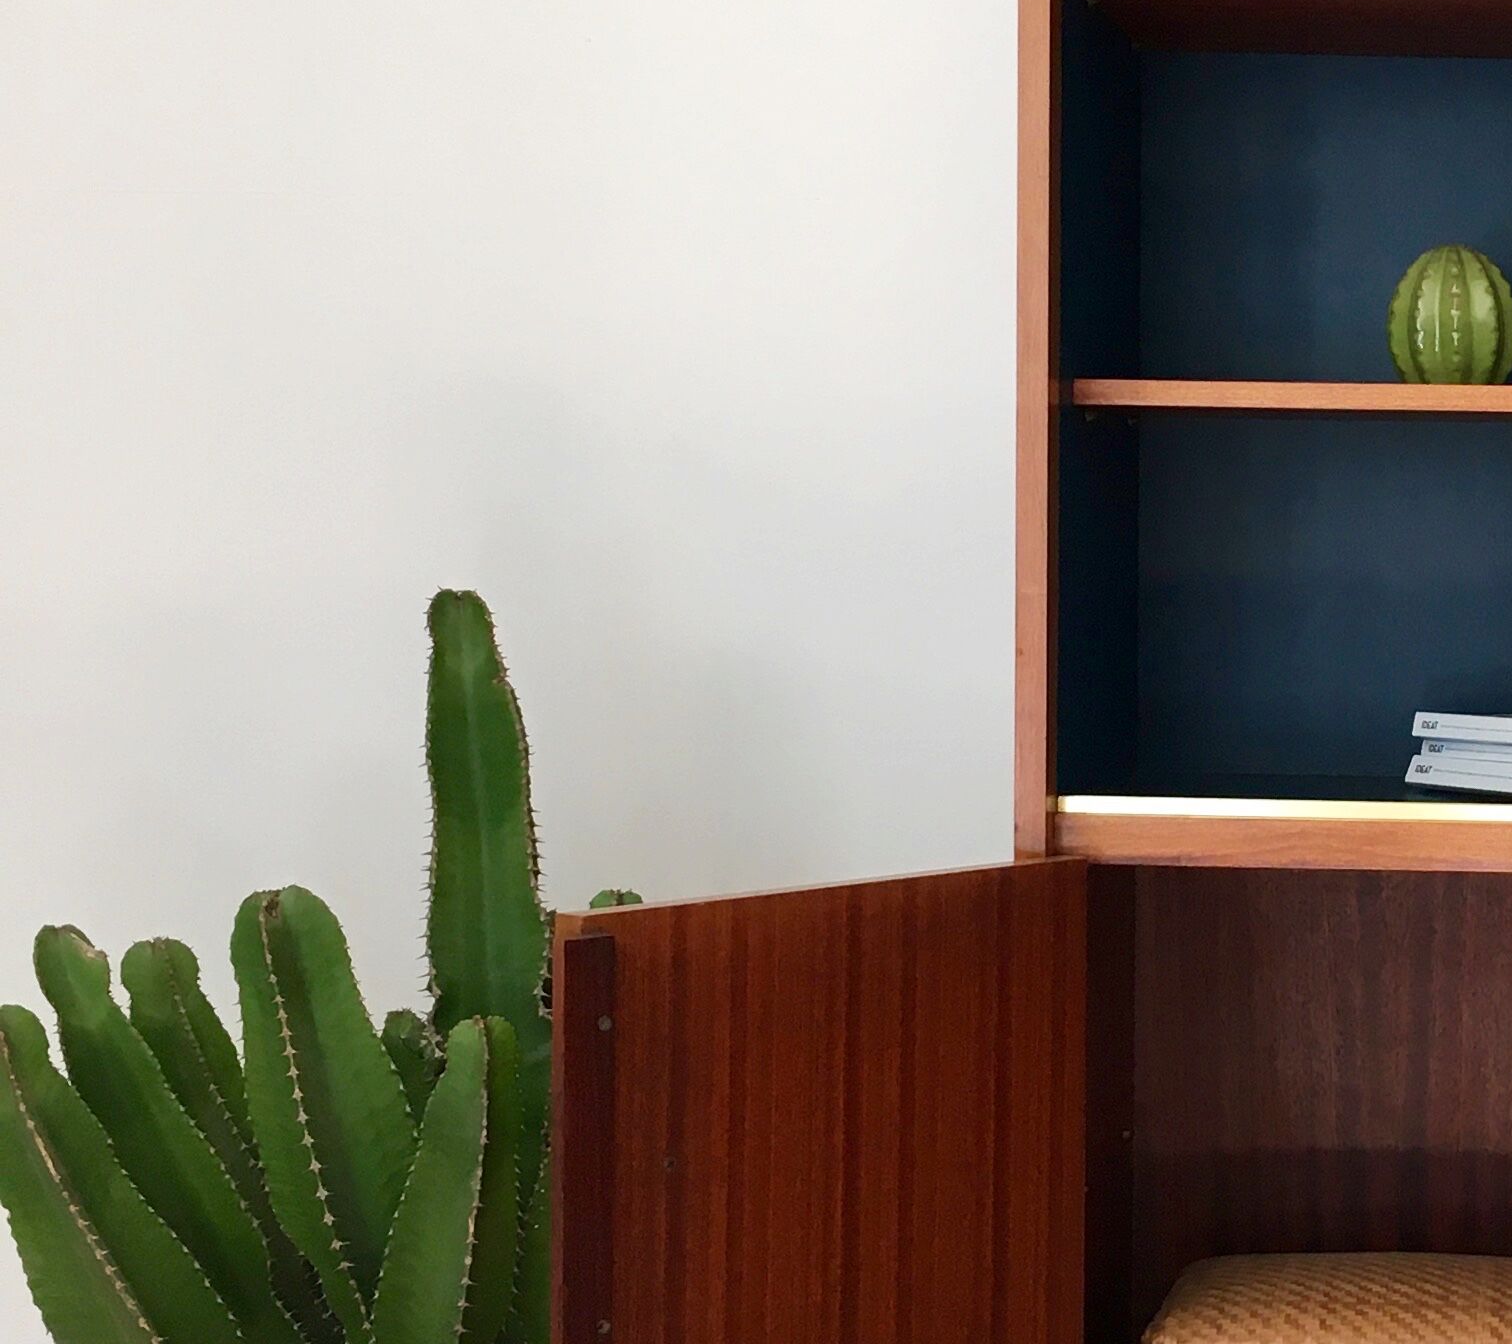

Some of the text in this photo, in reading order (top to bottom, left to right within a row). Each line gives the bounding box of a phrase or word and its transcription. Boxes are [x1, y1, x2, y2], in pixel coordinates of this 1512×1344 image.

[1421, 720, 1439, 730] IDEAT
[1428, 743, 1444, 753] IDEAT
[1414, 764, 1433, 774] IDEAT
